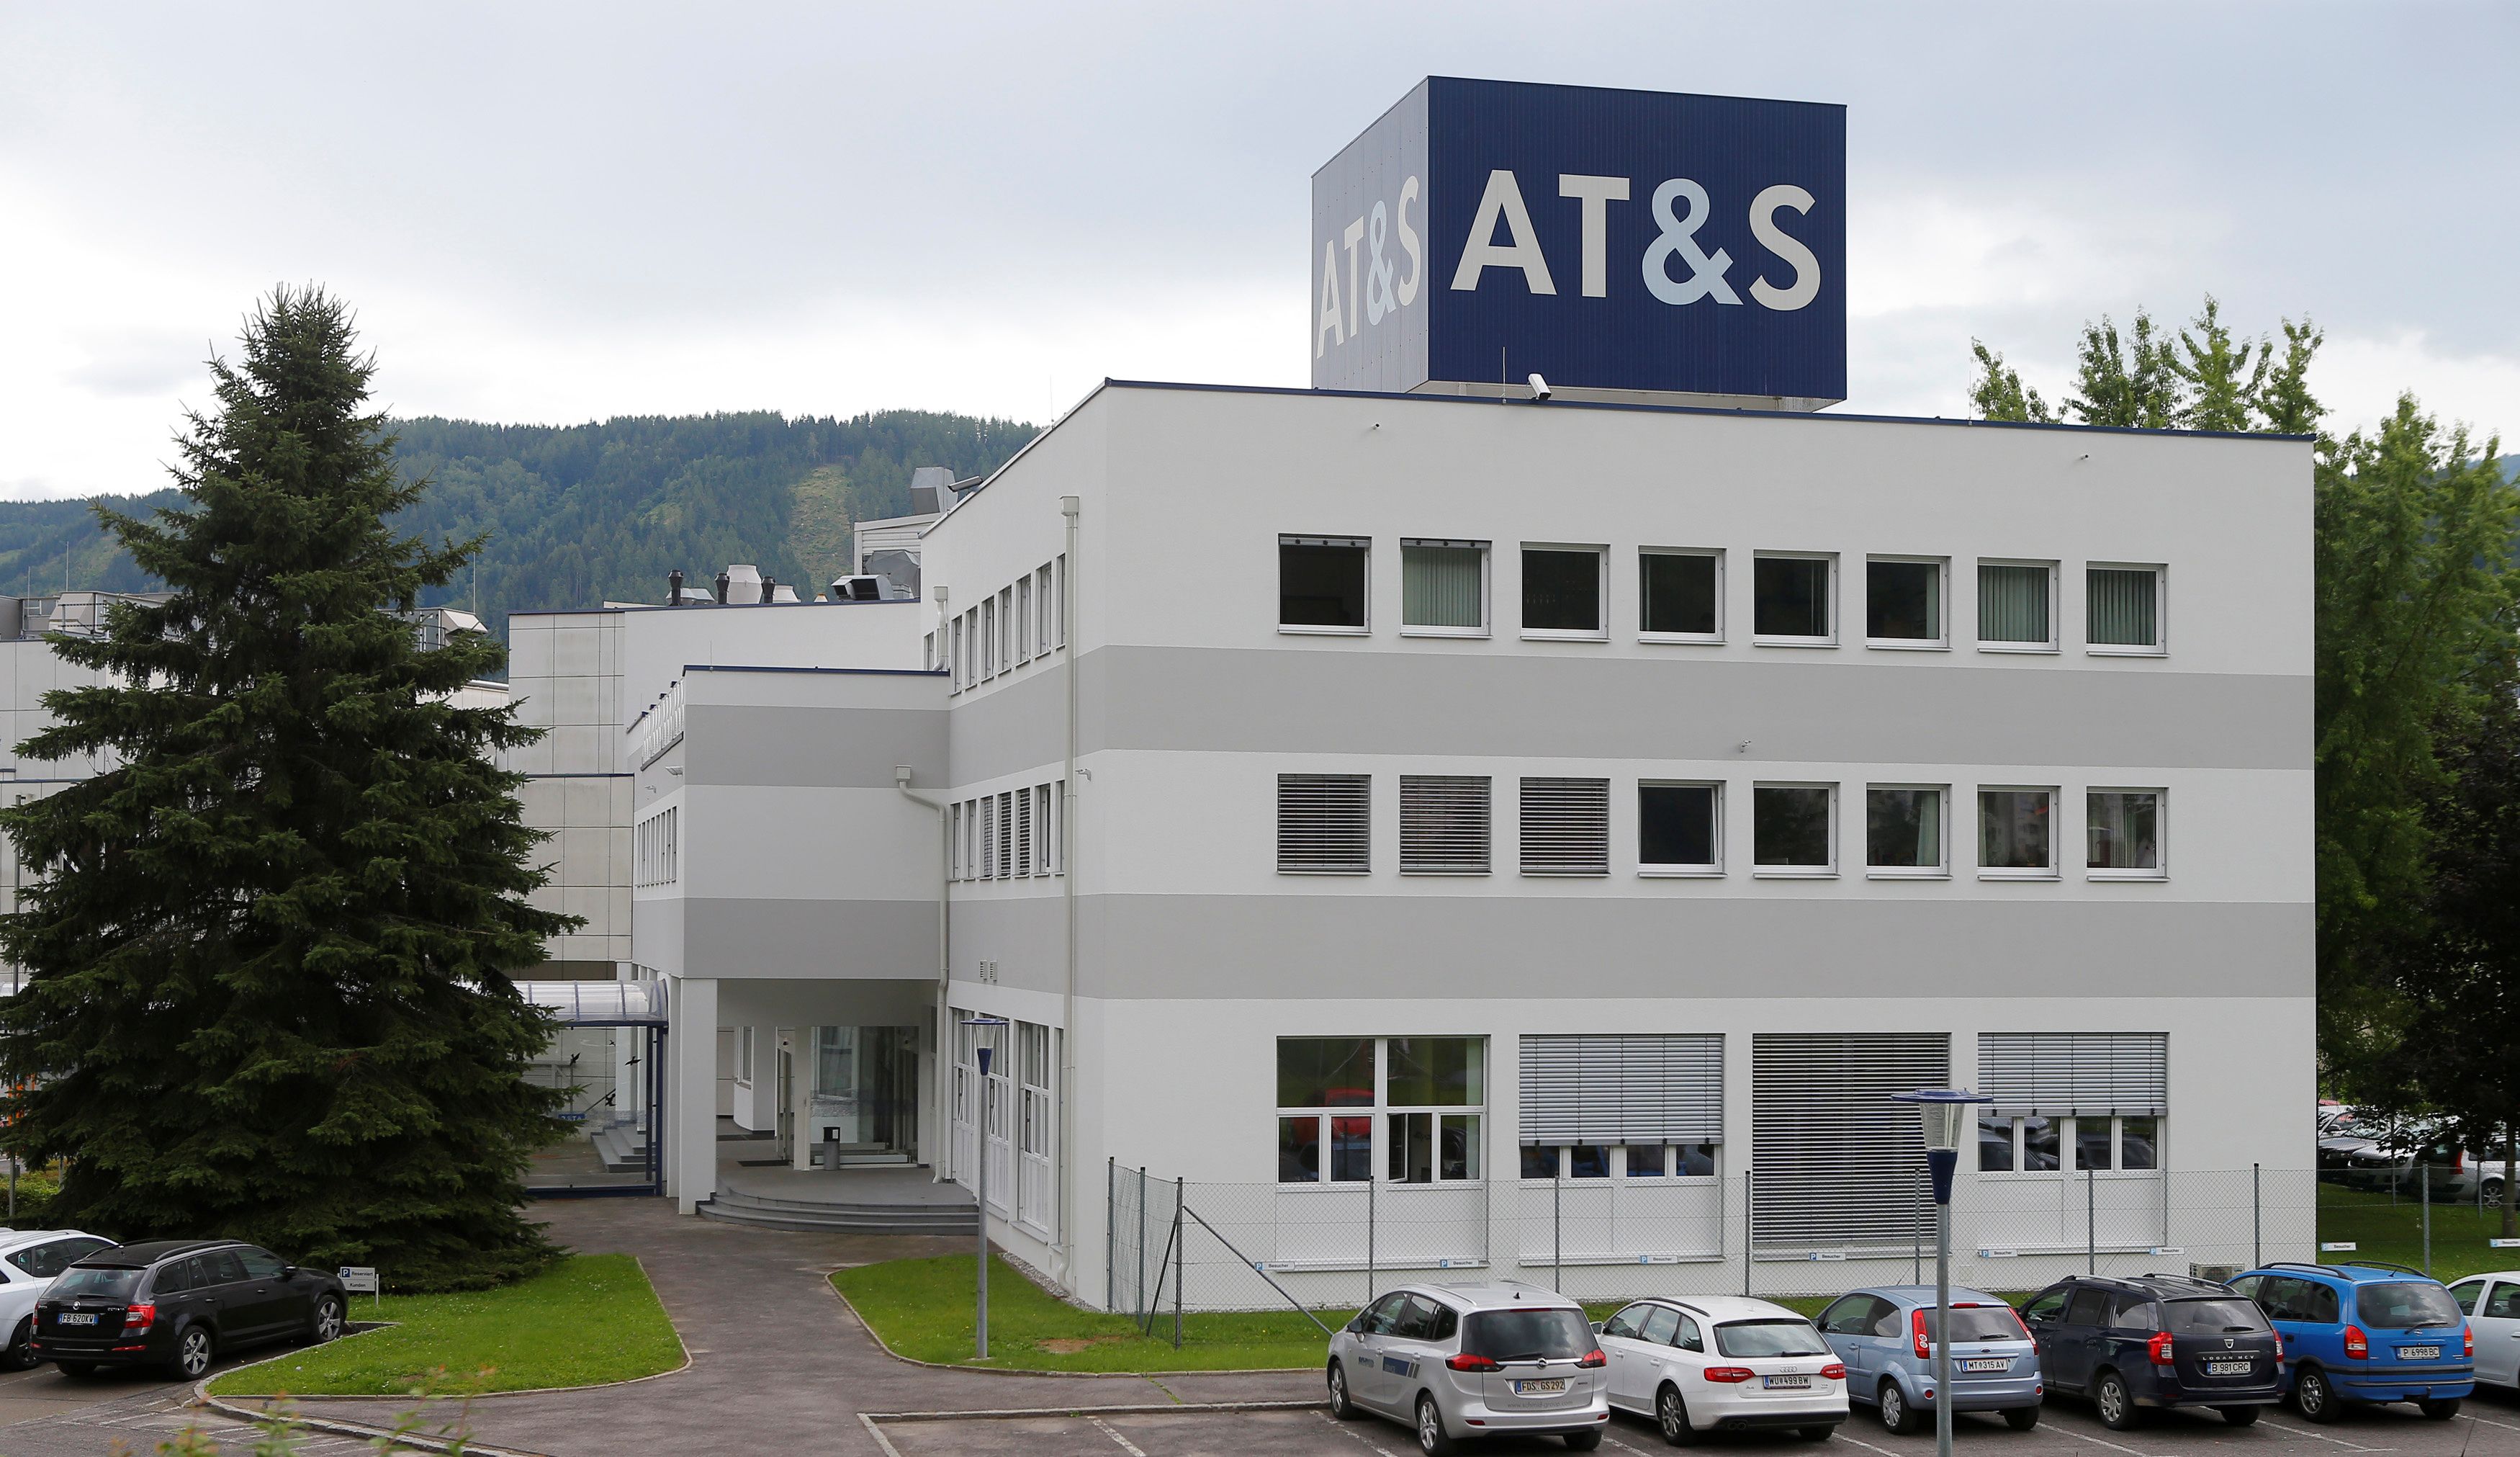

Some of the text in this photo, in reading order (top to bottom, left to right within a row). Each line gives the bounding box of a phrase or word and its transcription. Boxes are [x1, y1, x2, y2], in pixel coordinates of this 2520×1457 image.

[1449, 169, 1821, 311] AT&S
[1317, 175, 1421, 359] AT&S
[63, 1314, 71, 1322] FB
[1968, 1360, 1977, 1369] MT
[2212, 1363, 2218, 1372] B
[1522, 1382, 1536, 1391] FDS
